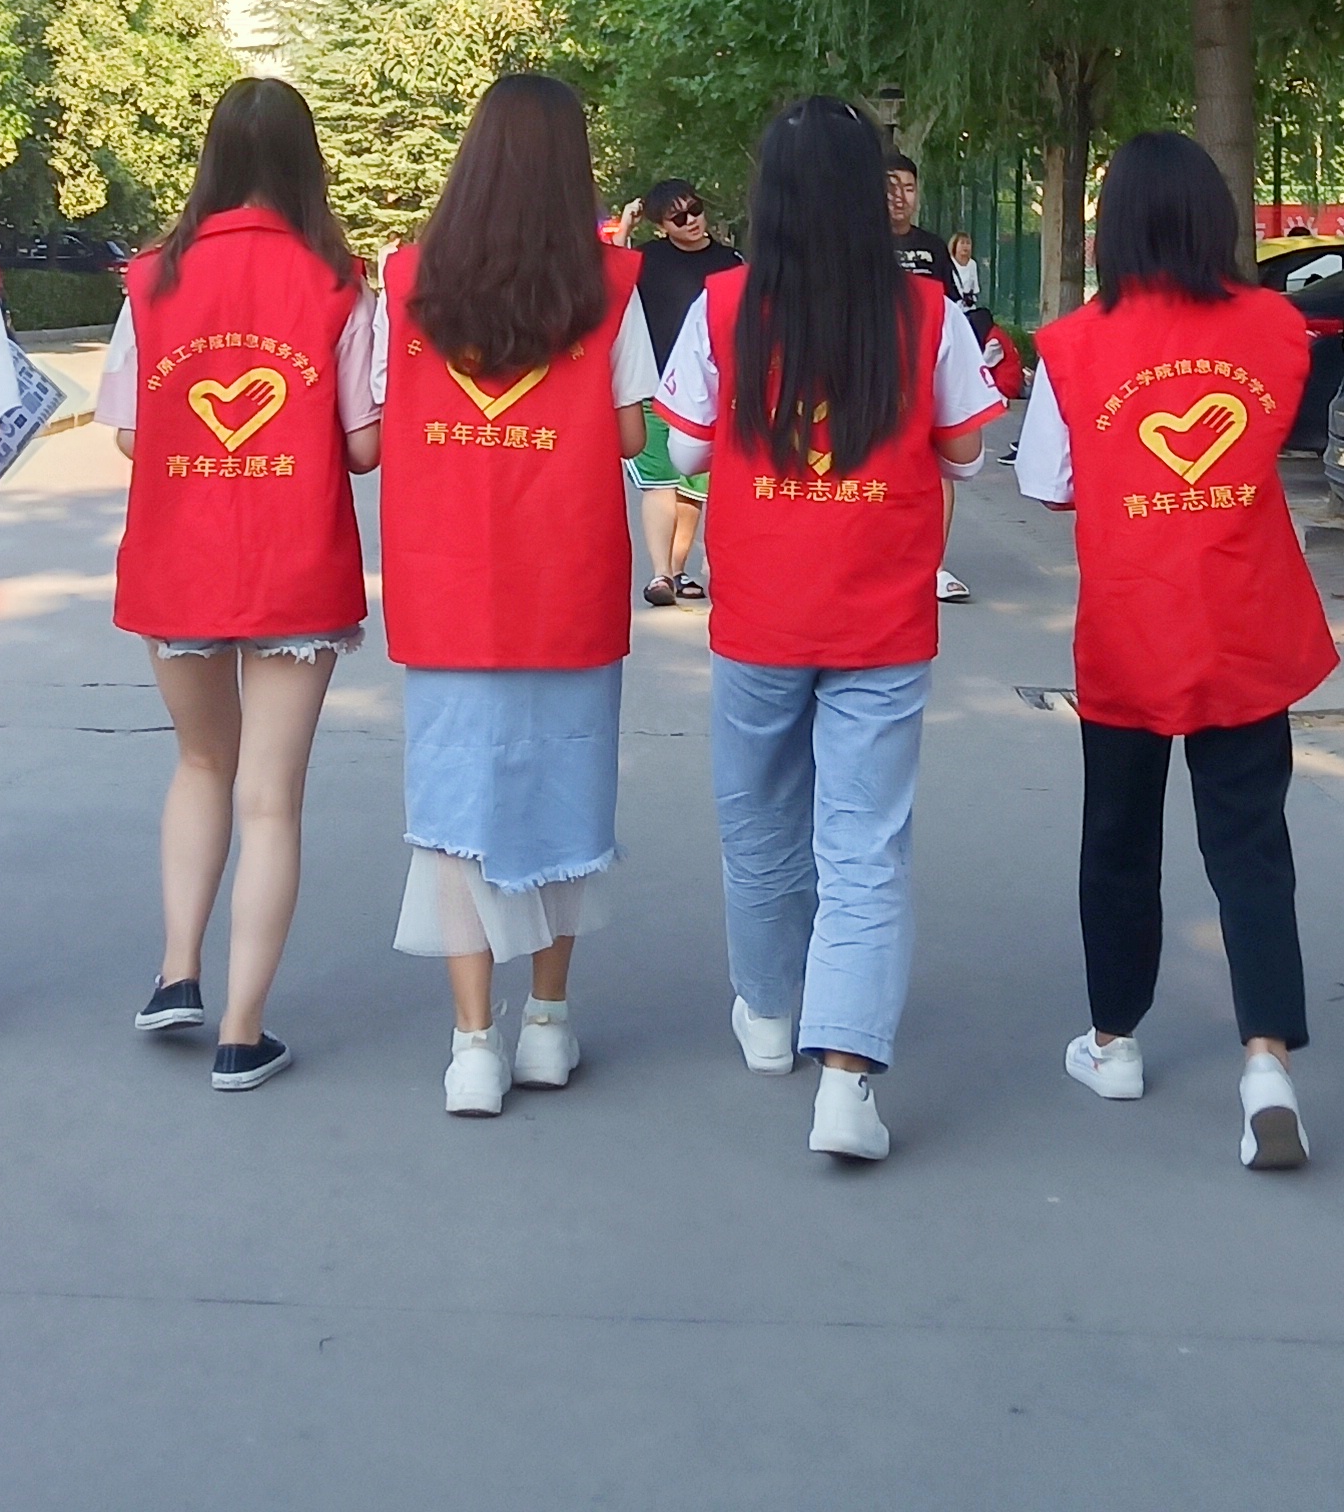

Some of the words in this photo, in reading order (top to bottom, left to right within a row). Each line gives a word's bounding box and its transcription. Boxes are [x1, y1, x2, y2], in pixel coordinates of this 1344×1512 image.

[146, 332, 320, 391] 中原工学院信息商务学院
[1095, 358, 1277, 432] 中原工学院信息商务学院
[423, 421, 558, 451] 青年志愿者
[165, 454, 297, 478] 青年志愿者
[753, 475, 888, 503] 青年志愿者
[1123, 483, 1258, 519] 青年志愿者
